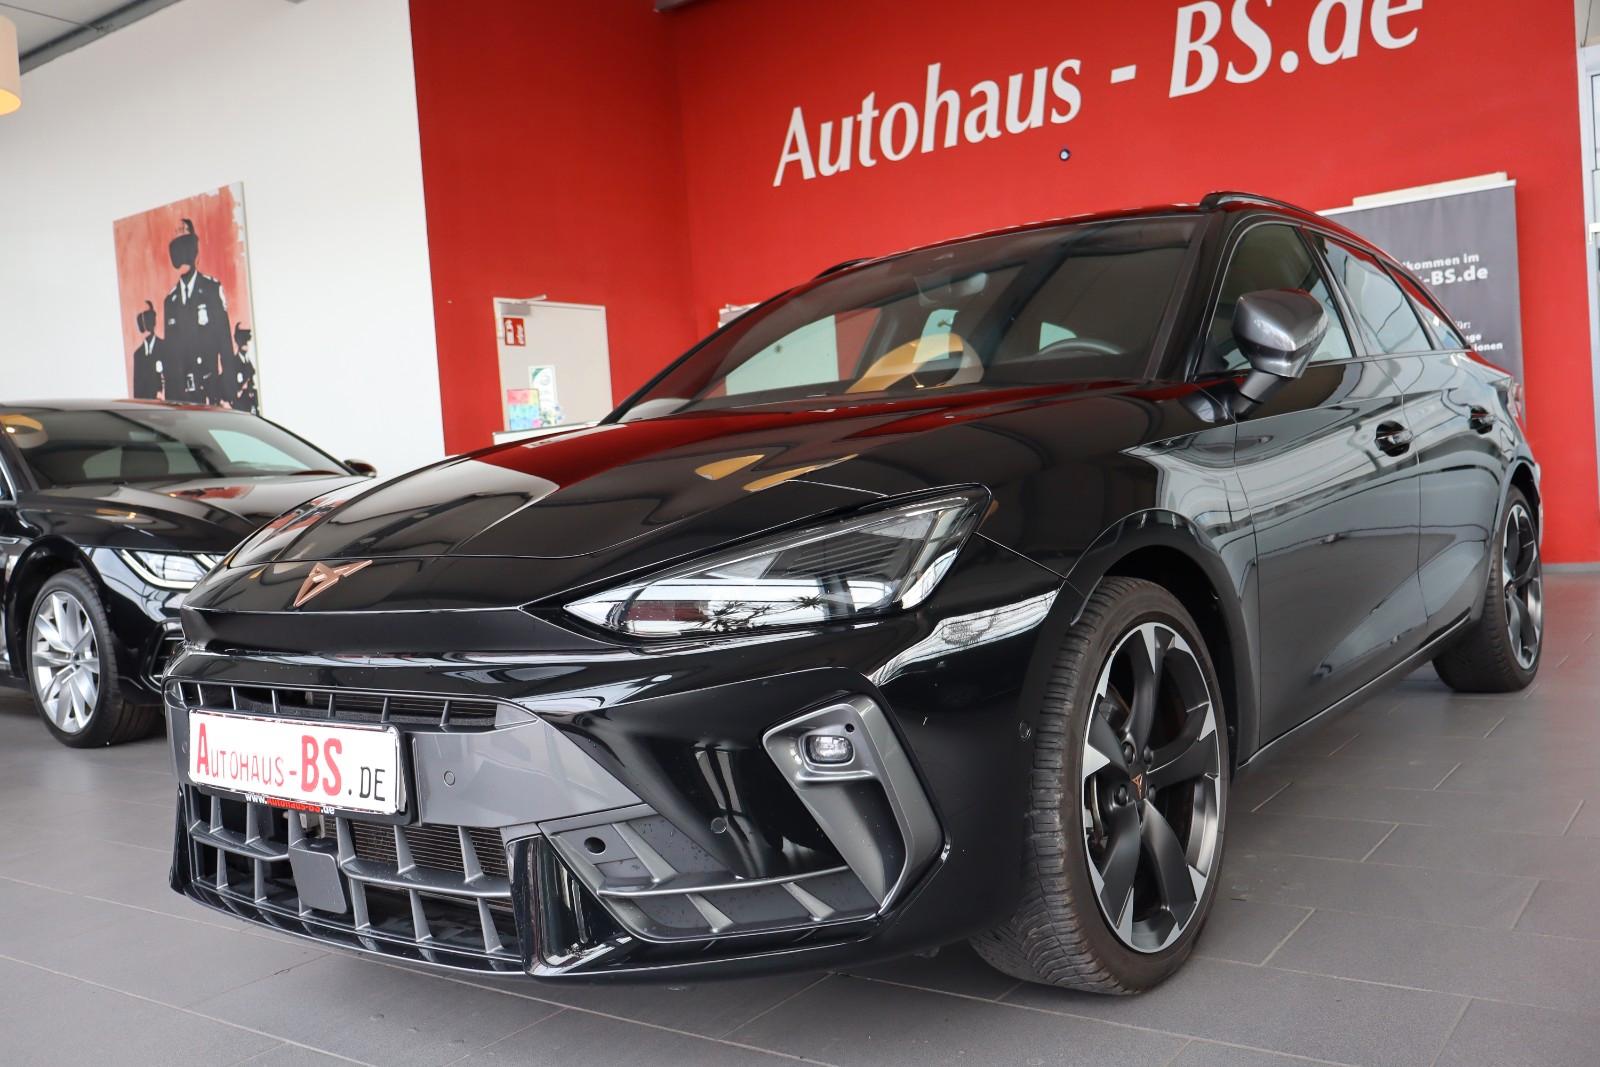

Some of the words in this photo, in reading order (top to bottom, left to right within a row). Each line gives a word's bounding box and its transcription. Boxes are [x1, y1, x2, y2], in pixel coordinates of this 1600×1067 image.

[773, 58, 1082, 187] Autohaus
[1110, 64, 1137, 84] -
[1168, 0, 1424, 98] BS.de
[1402, 256, 1460, 271] kommen
[1463, 253, 1480, 264] im
[1419, 265, 1489, 286] -BS.de
